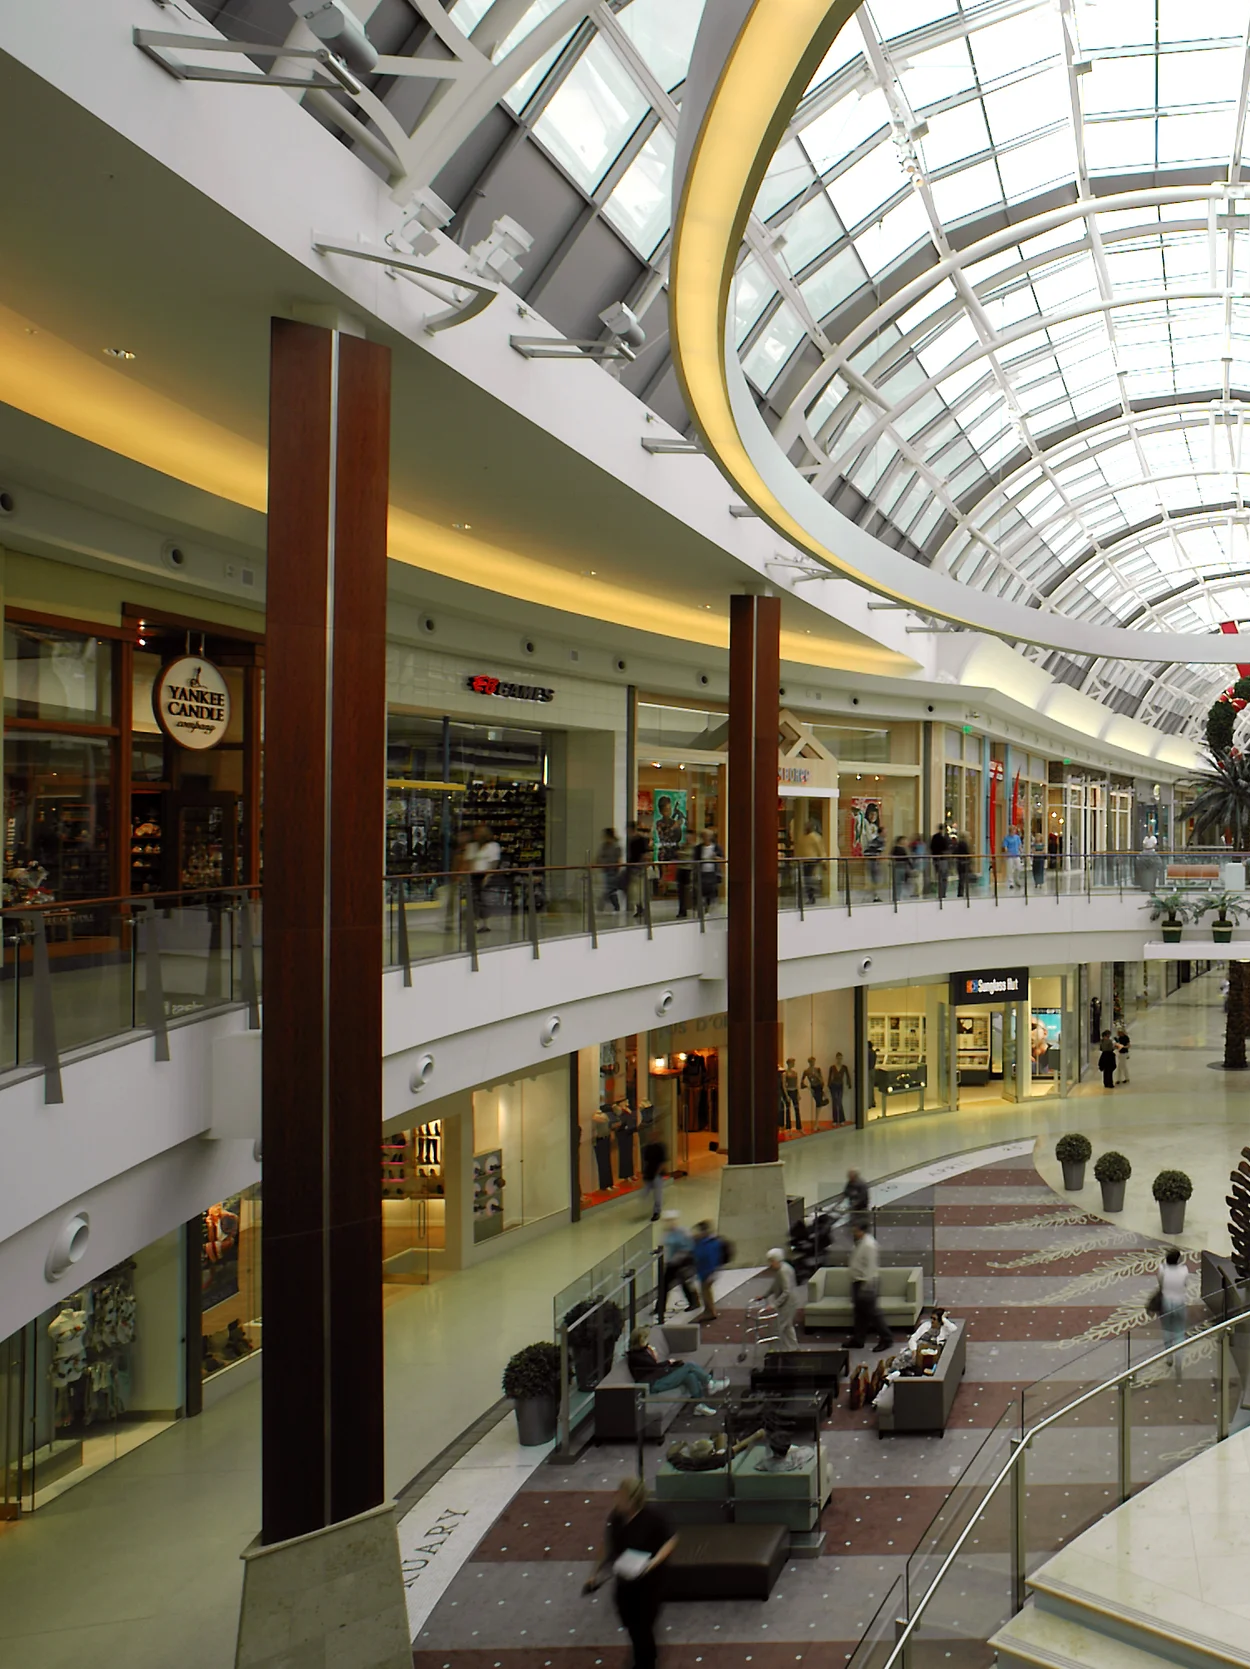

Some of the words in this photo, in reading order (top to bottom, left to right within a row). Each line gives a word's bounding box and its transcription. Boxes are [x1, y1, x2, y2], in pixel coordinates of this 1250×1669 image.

[167, 685, 225, 707] YANKEE
[499, 681, 555, 702] GAMES
[167, 701, 225, 721] CANDLE
[176, 721, 216, 734] company
[978, 979, 1006, 995] Sunglass
[1007, 977, 1018, 991] Hut
